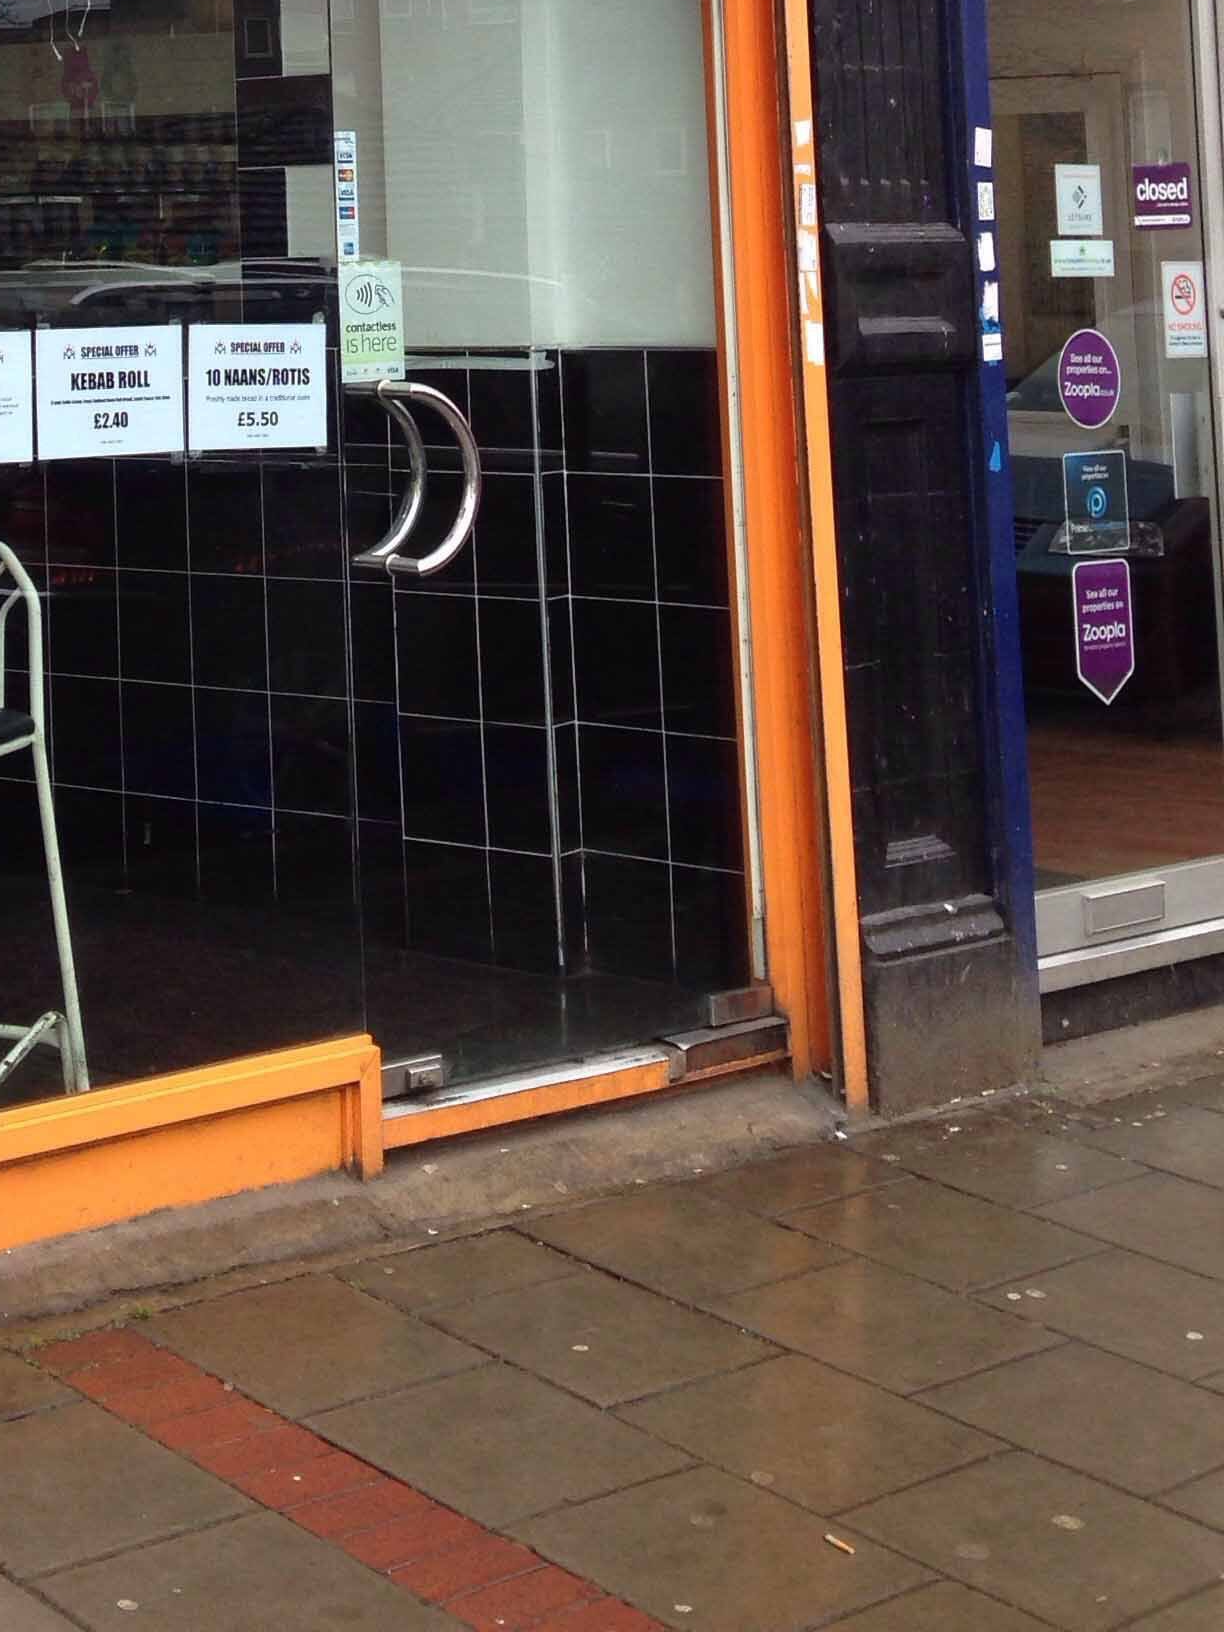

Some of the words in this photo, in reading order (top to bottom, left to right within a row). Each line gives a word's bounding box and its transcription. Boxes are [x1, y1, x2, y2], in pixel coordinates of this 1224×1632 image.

[1136, 176, 1188, 201] closed
[345, 320, 397, 334] contactless
[80, 345, 114, 358] SPECIAL
[115, 344, 139, 357] OFFER
[230, 341, 262, 353] SPECIAL
[263, 341, 285, 353] OFFER
[346, 337, 359, 354] is
[361, 334, 397, 353] here
[70, 371, 115, 391] KEBAB
[118, 370, 151, 389] ROLL
[205, 368, 221, 387] 10
[224, 367, 311, 386] NAANS/ROTIS
[93, 411, 129, 430] £2.40
[237, 410, 279, 427] £5.50
[1082, 601, 1115, 614] properties
[1082, 620, 1126, 642] Zoopla
